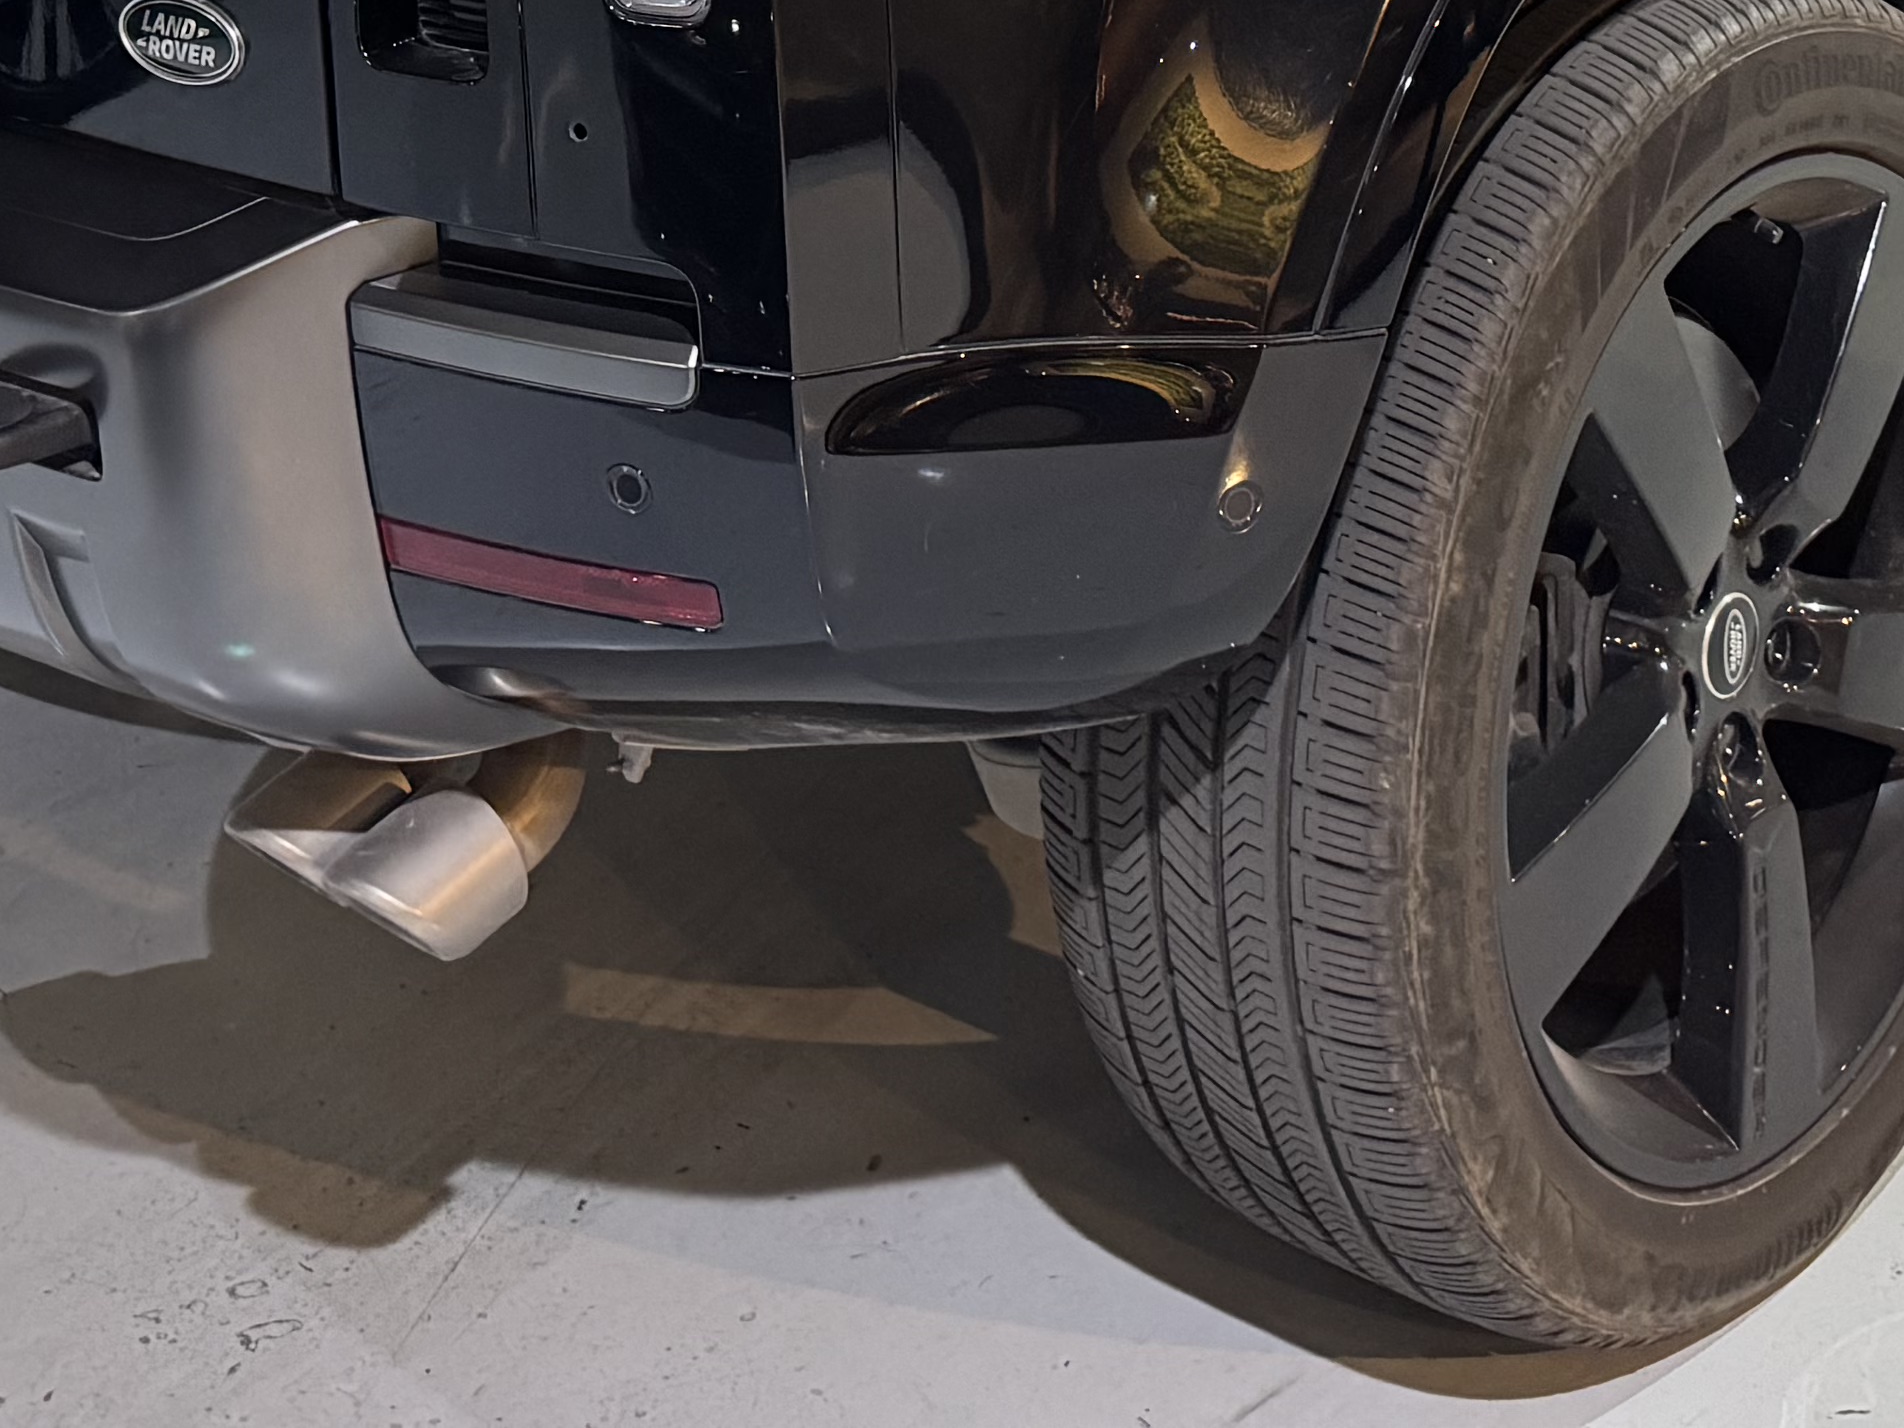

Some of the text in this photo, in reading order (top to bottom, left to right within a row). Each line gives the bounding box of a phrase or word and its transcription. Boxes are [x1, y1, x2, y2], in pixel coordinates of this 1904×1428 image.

[140, 9, 197, 40] LAND
[147, 35, 216, 68] ROVER
[1751, 44, 1904, 118] Continental
